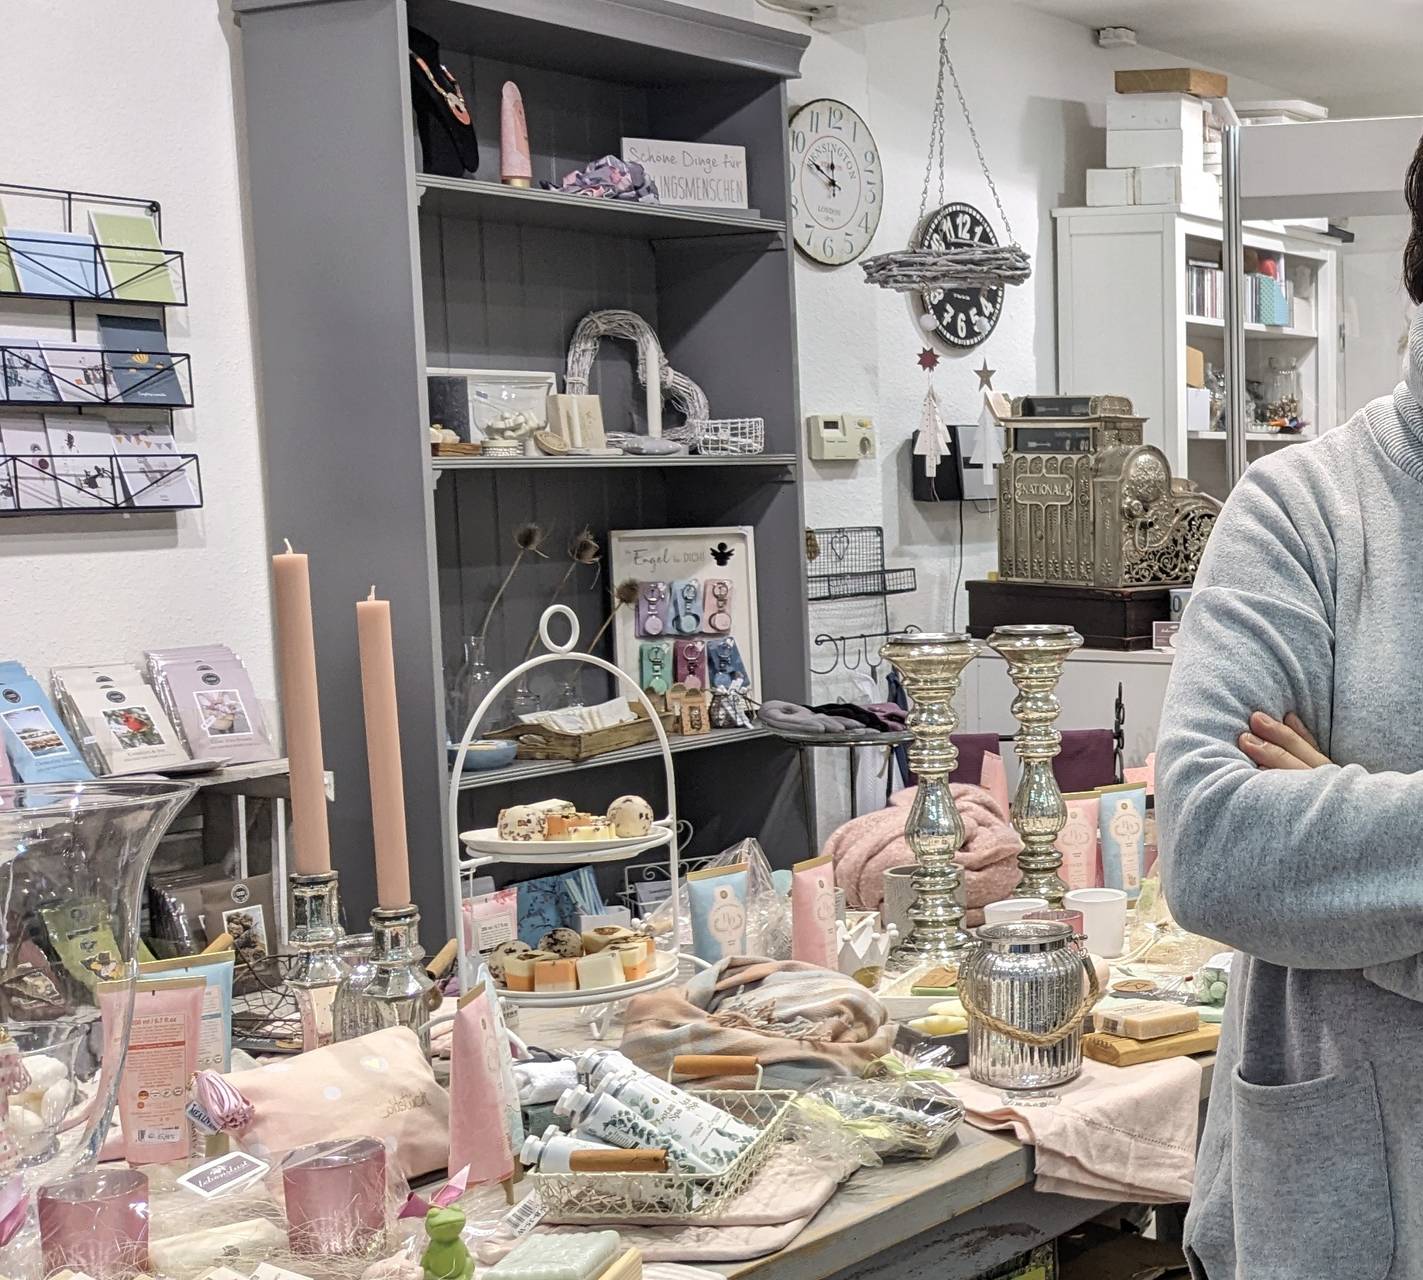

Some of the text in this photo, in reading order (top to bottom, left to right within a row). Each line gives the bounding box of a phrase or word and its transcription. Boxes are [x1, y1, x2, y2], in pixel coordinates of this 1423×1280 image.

[828, 107, 843, 130] 12
[682, 150, 719, 174] Dinge
[653, 175, 744, 203] INGSMENSCHEN
[956, 213, 971, 240] 12
[942, 303, 954, 326] 7
[980, 296, 994, 317] 4
[957, 312, 966, 338] 6
[1022, 483, 1065, 496] NATIONAL
